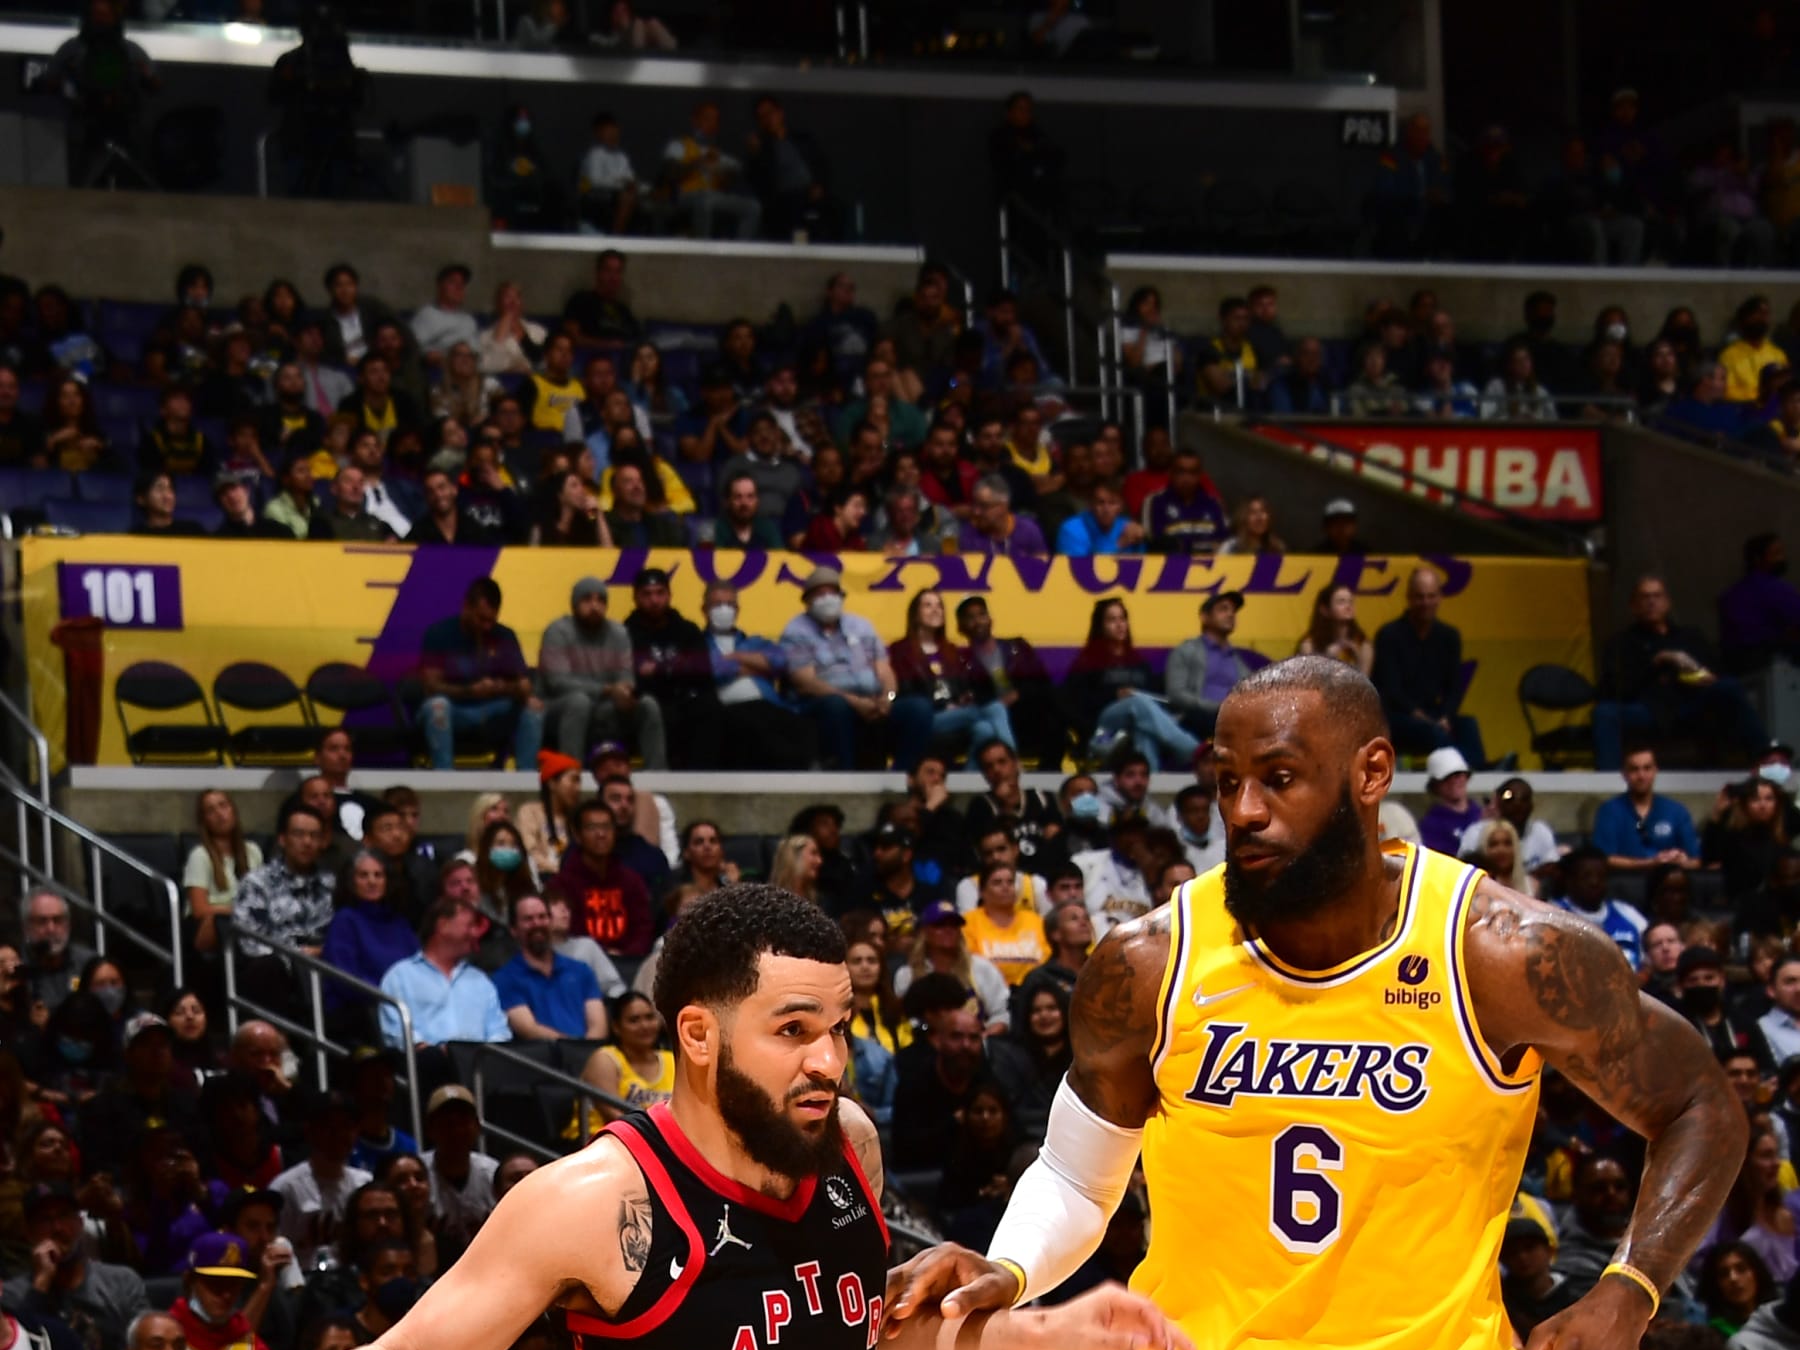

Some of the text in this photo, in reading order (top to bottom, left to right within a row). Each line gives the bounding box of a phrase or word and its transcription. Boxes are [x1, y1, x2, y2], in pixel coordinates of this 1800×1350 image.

[1296, 444, 1592, 508] SHIBA
[82, 569, 156, 624] 101
[1385, 989, 1441, 1010] bibigo
[1184, 1021, 1434, 1114] LAKERS
[831, 1203, 867, 1230] Sun Life
[1269, 1123, 1345, 1254] 6
